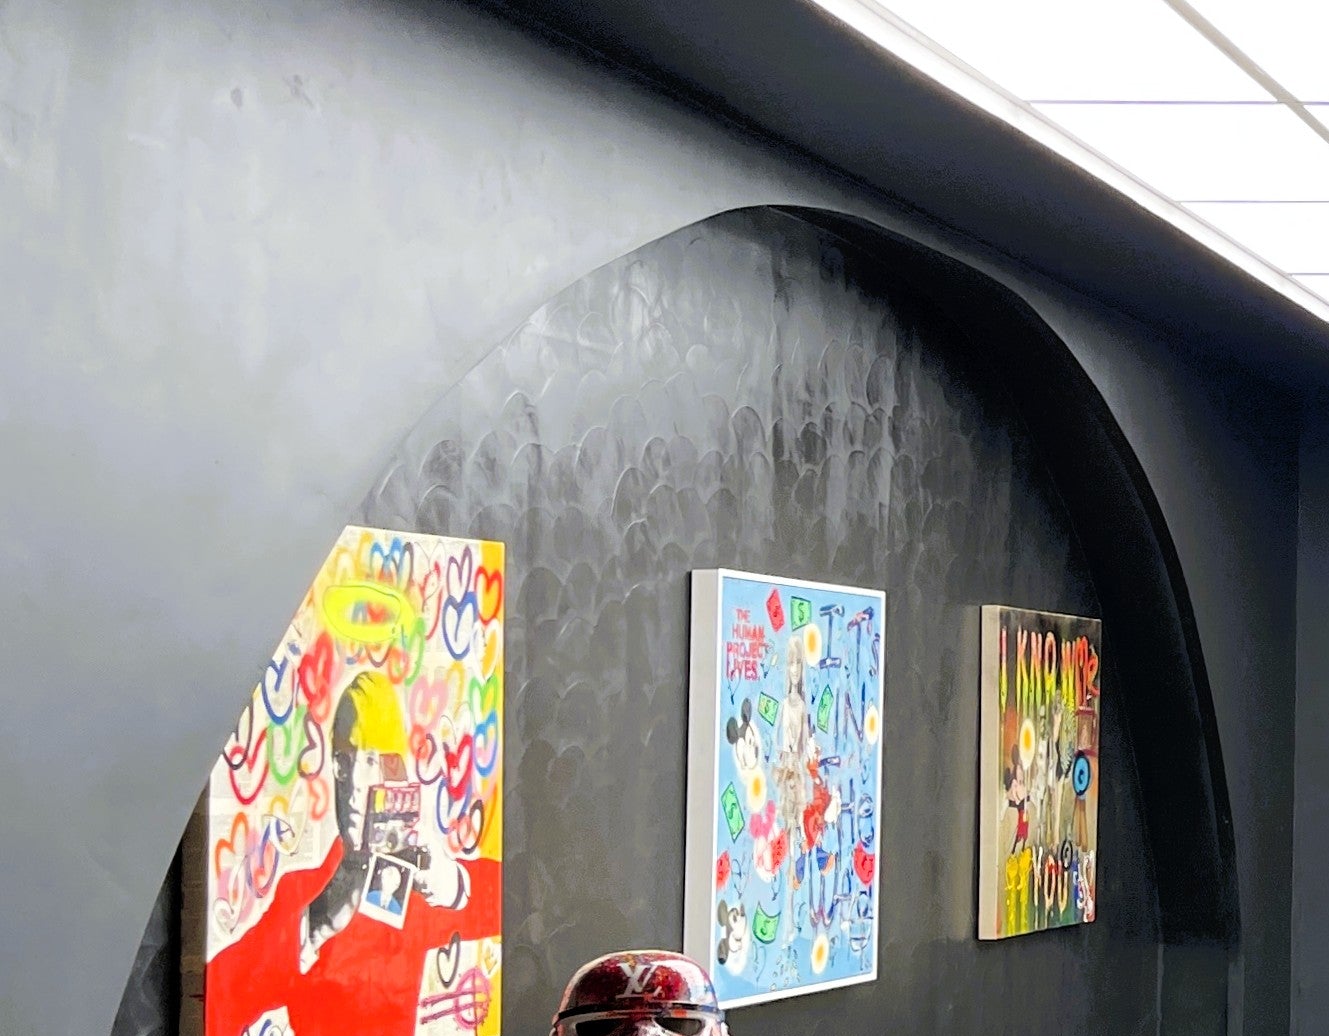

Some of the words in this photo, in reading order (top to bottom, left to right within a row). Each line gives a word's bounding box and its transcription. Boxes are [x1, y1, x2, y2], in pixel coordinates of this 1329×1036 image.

[735, 608, 750, 622] THE
[731, 624, 765, 641] HUMAN
[727, 642, 769, 659] PROJECT
